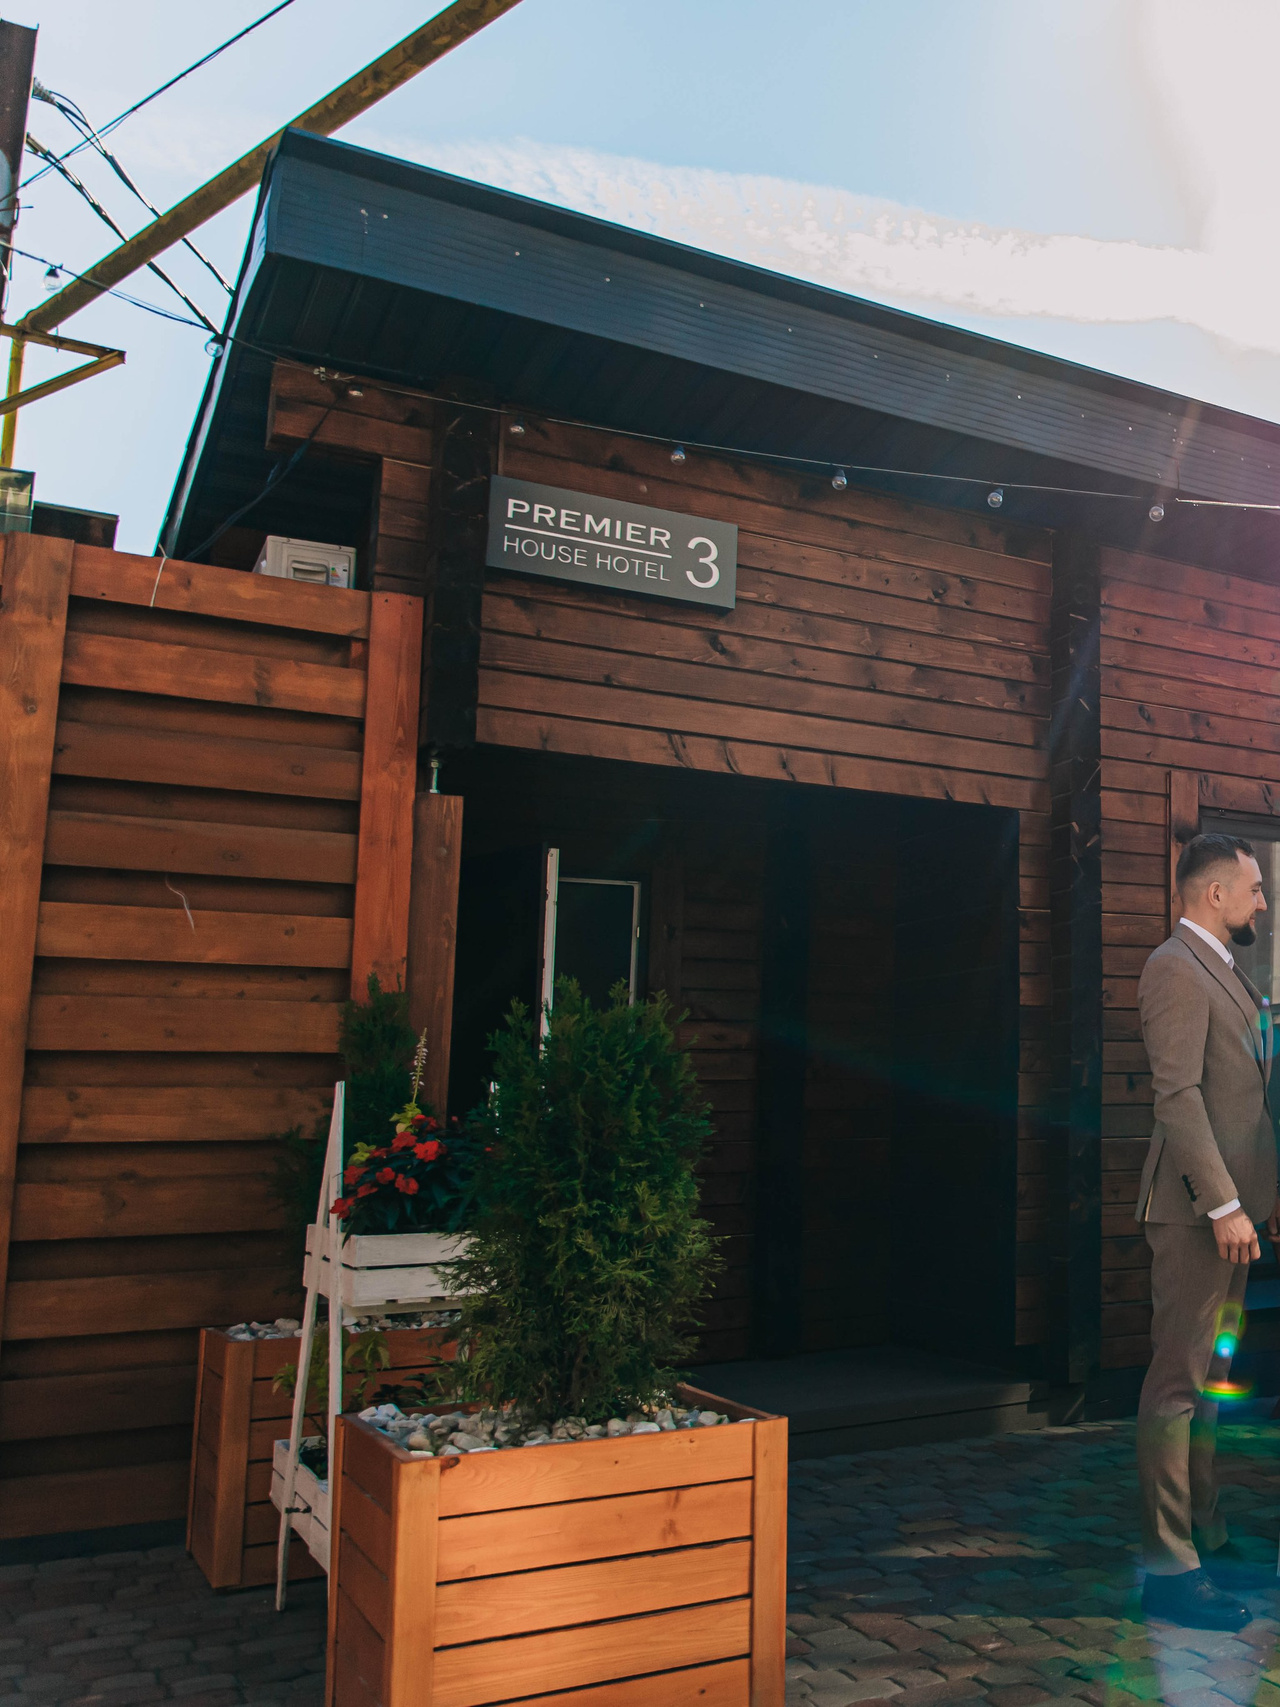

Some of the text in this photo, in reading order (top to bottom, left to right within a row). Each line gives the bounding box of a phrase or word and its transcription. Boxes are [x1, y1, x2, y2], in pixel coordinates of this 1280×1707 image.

[507, 498, 672, 549] PREMIER
[503, 535, 671, 582] HOUSE HOTEL
[686, 536, 720, 589] 3
